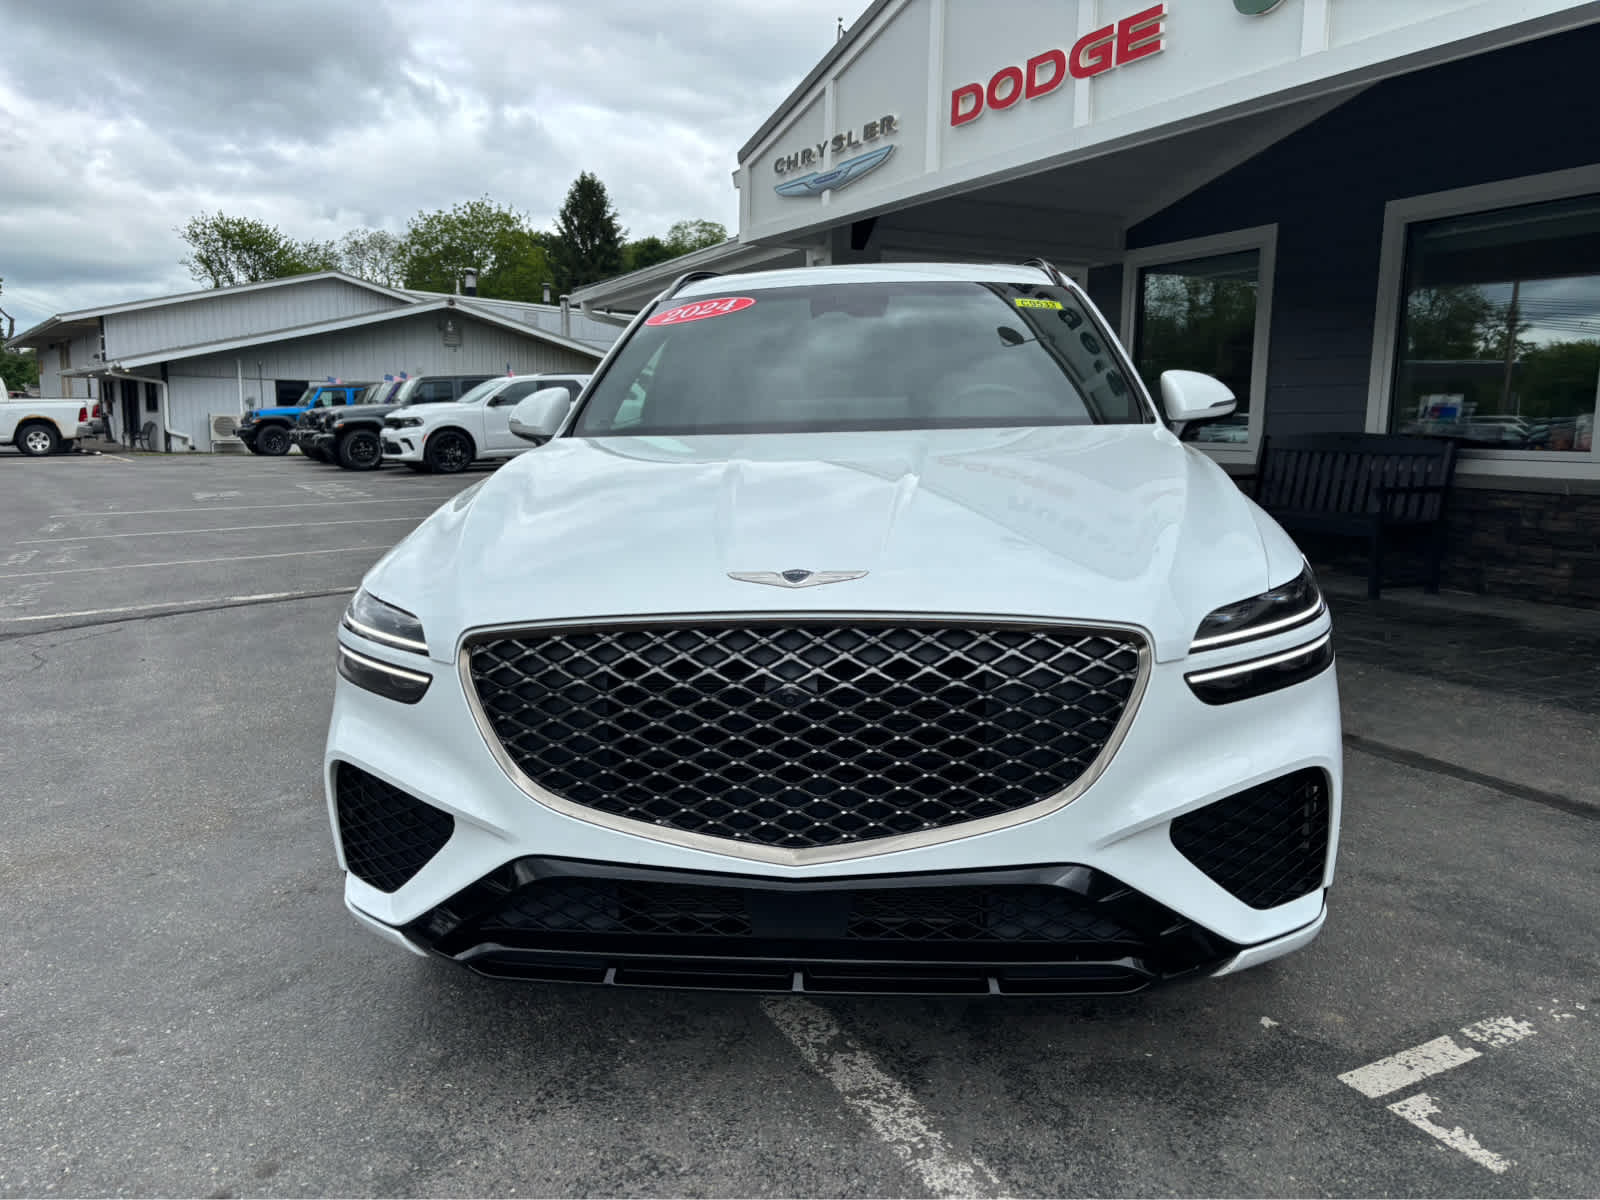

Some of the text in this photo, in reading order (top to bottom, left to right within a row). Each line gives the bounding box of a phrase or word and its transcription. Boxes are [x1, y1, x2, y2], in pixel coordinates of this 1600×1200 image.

[950, 3, 1165, 127] DODGE
[774, 114, 897, 174] CHRYSLER
[661, 298, 738, 323] 2024
